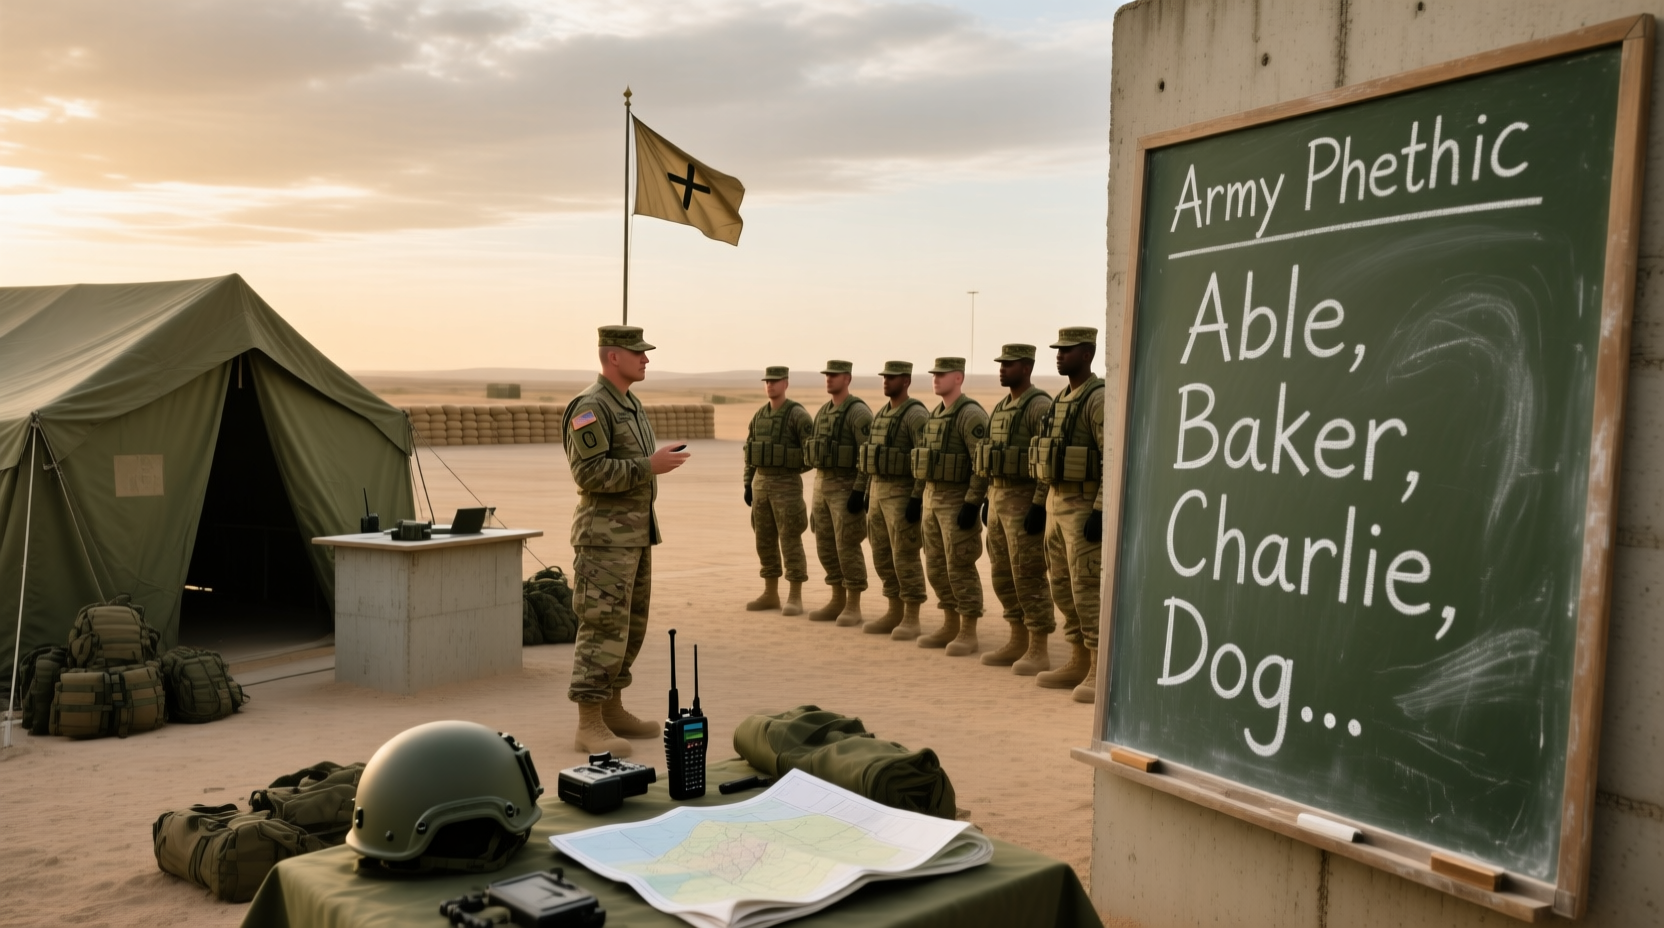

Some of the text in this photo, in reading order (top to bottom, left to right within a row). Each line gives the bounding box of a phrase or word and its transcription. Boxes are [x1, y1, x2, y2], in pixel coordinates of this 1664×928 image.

[1170, 114, 1530, 239] Army Phethic
[1180, 264, 1366, 373] Able,
[1173, 382, 1420, 503] Baker,
[1166, 489, 1456, 640] Charlie,
[1156, 596, 1362, 757] Dog...
